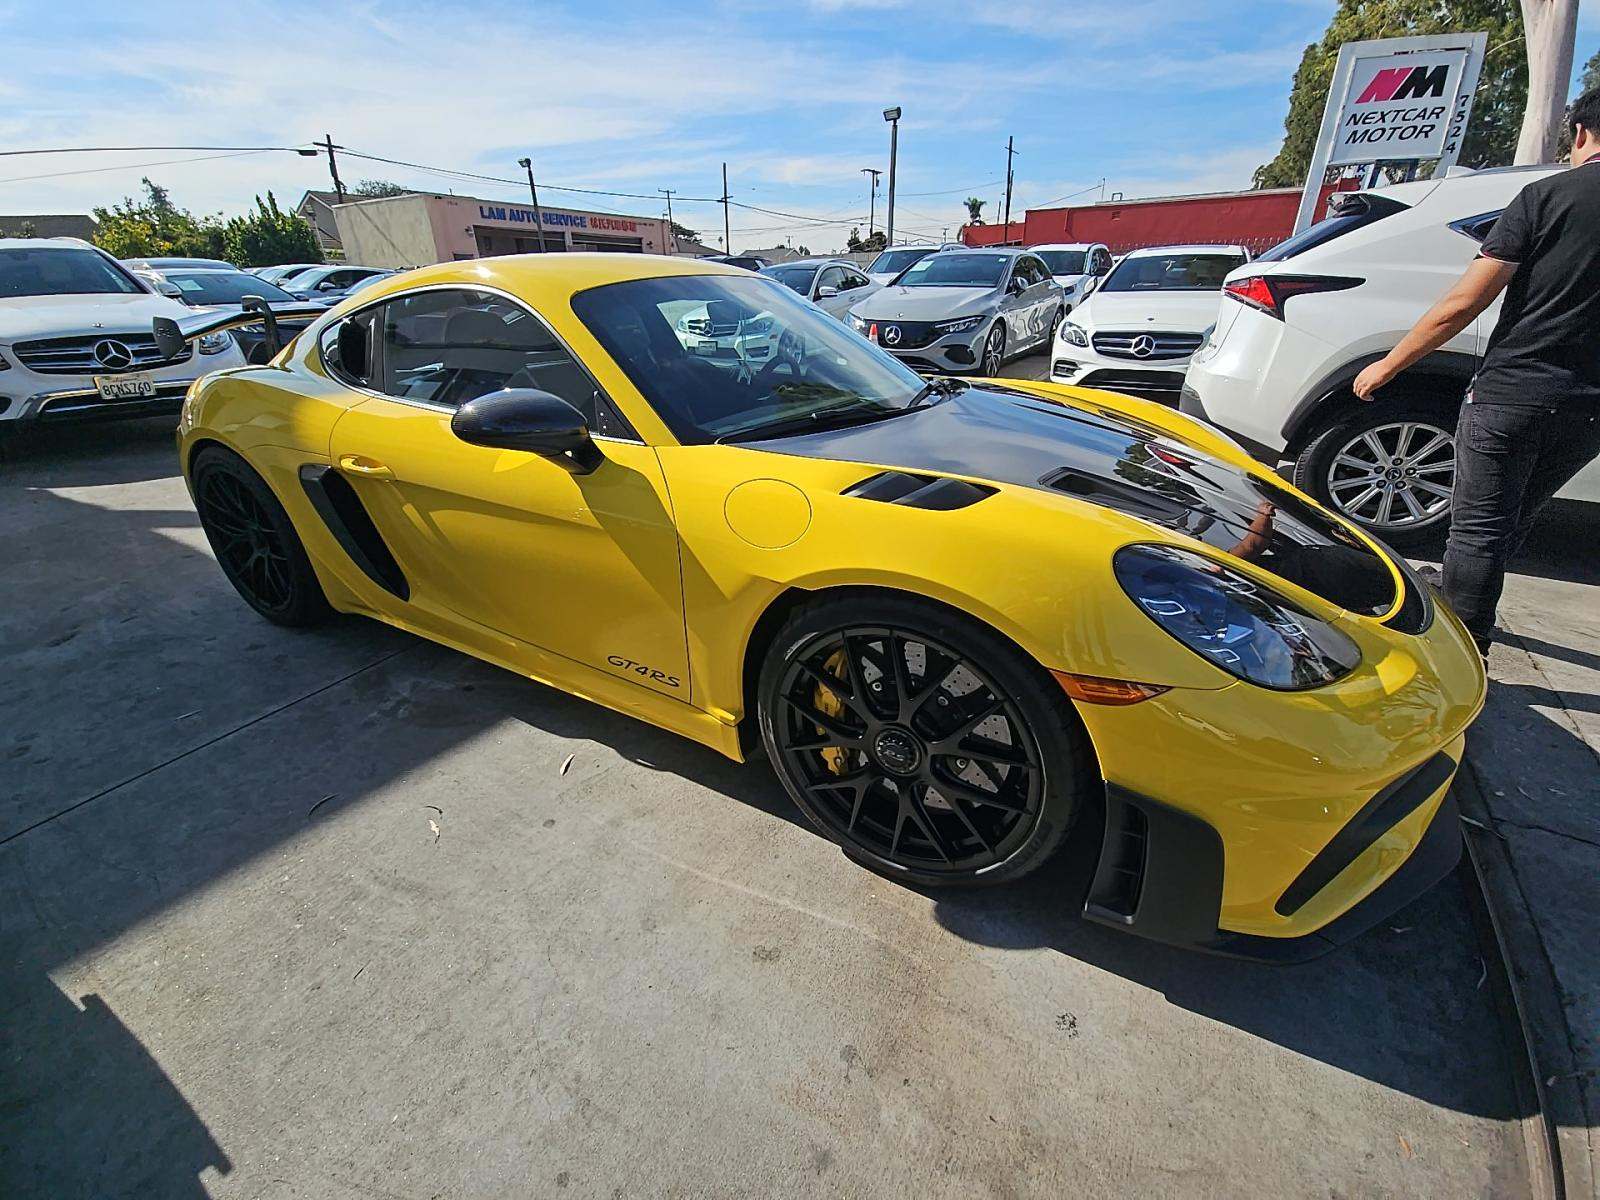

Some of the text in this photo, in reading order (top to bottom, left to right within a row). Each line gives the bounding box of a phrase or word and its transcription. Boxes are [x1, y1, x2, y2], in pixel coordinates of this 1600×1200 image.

[1345, 106, 1446, 126] NEXTCAR
[1446, 95, 1469, 154] 7524
[1344, 124, 1436, 144] MOTOR
[479, 206, 506, 221] LAM
[509, 208, 538, 224] AUTO
[542, 212, 587, 228] SERVICE
